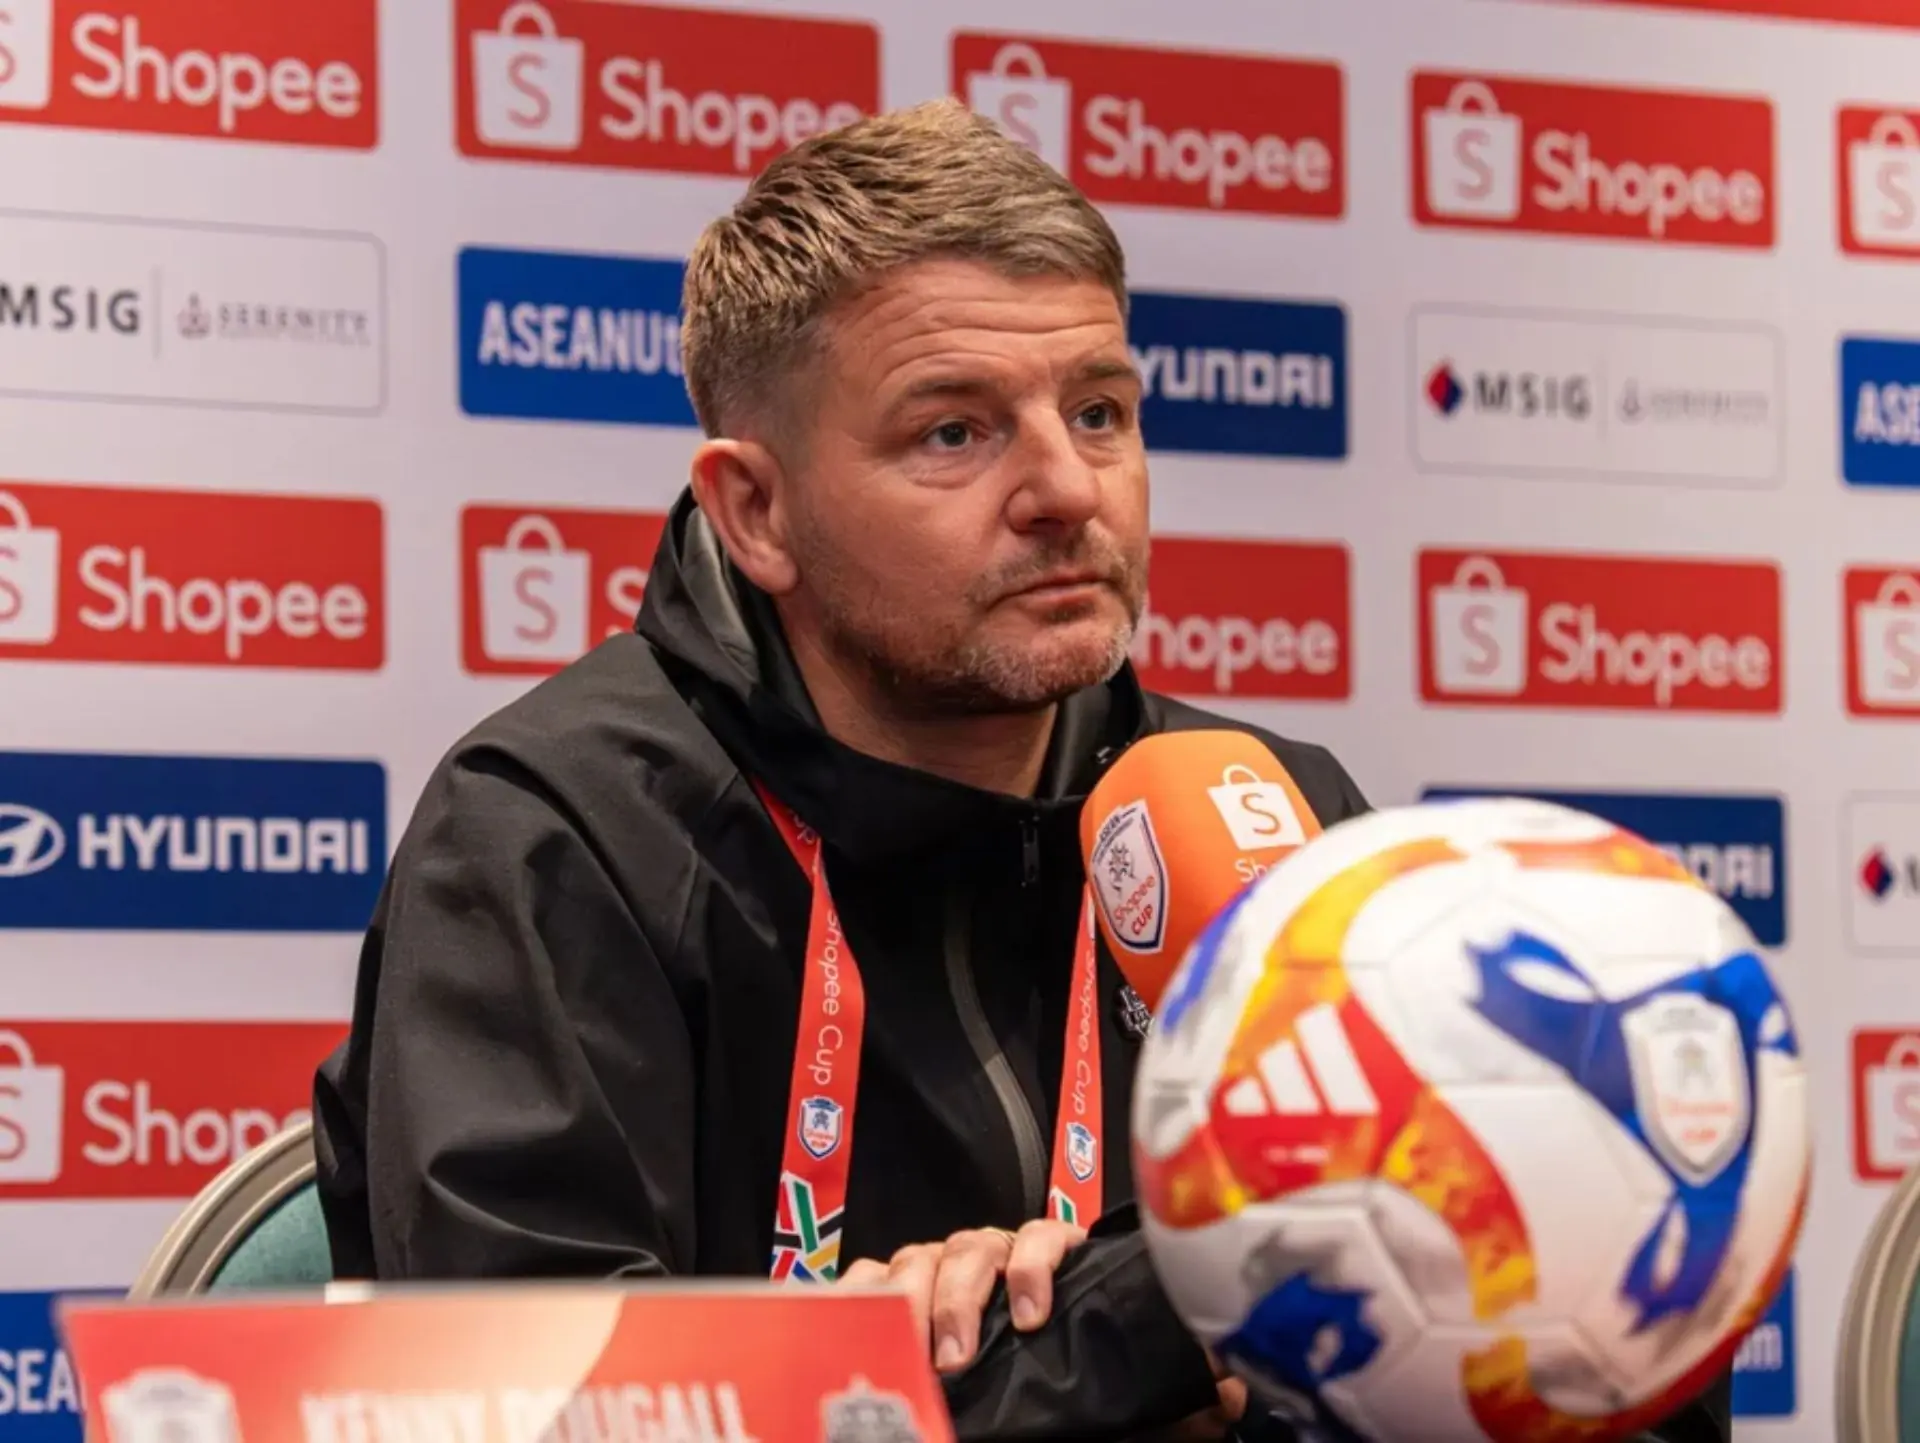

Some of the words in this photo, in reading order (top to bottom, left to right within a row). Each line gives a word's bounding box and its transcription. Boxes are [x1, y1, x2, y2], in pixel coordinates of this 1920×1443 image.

[71, 12, 362, 133] Shopee
[1084, 95, 1333, 207] Shopee
[1532, 129, 1766, 239] Shopee
[0, 283, 140, 335] MSIG
[1131, 346, 1333, 408] YUNDAI
[1472, 370, 1593, 421] MSIG
[78, 545, 368, 659] Shopee
[1128, 606, 1339, 693] hopee
[1539, 602, 1770, 706] Shopee
[78, 814, 369, 875] HYUNDAI
[807, 1024, 844, 1086] Cup
